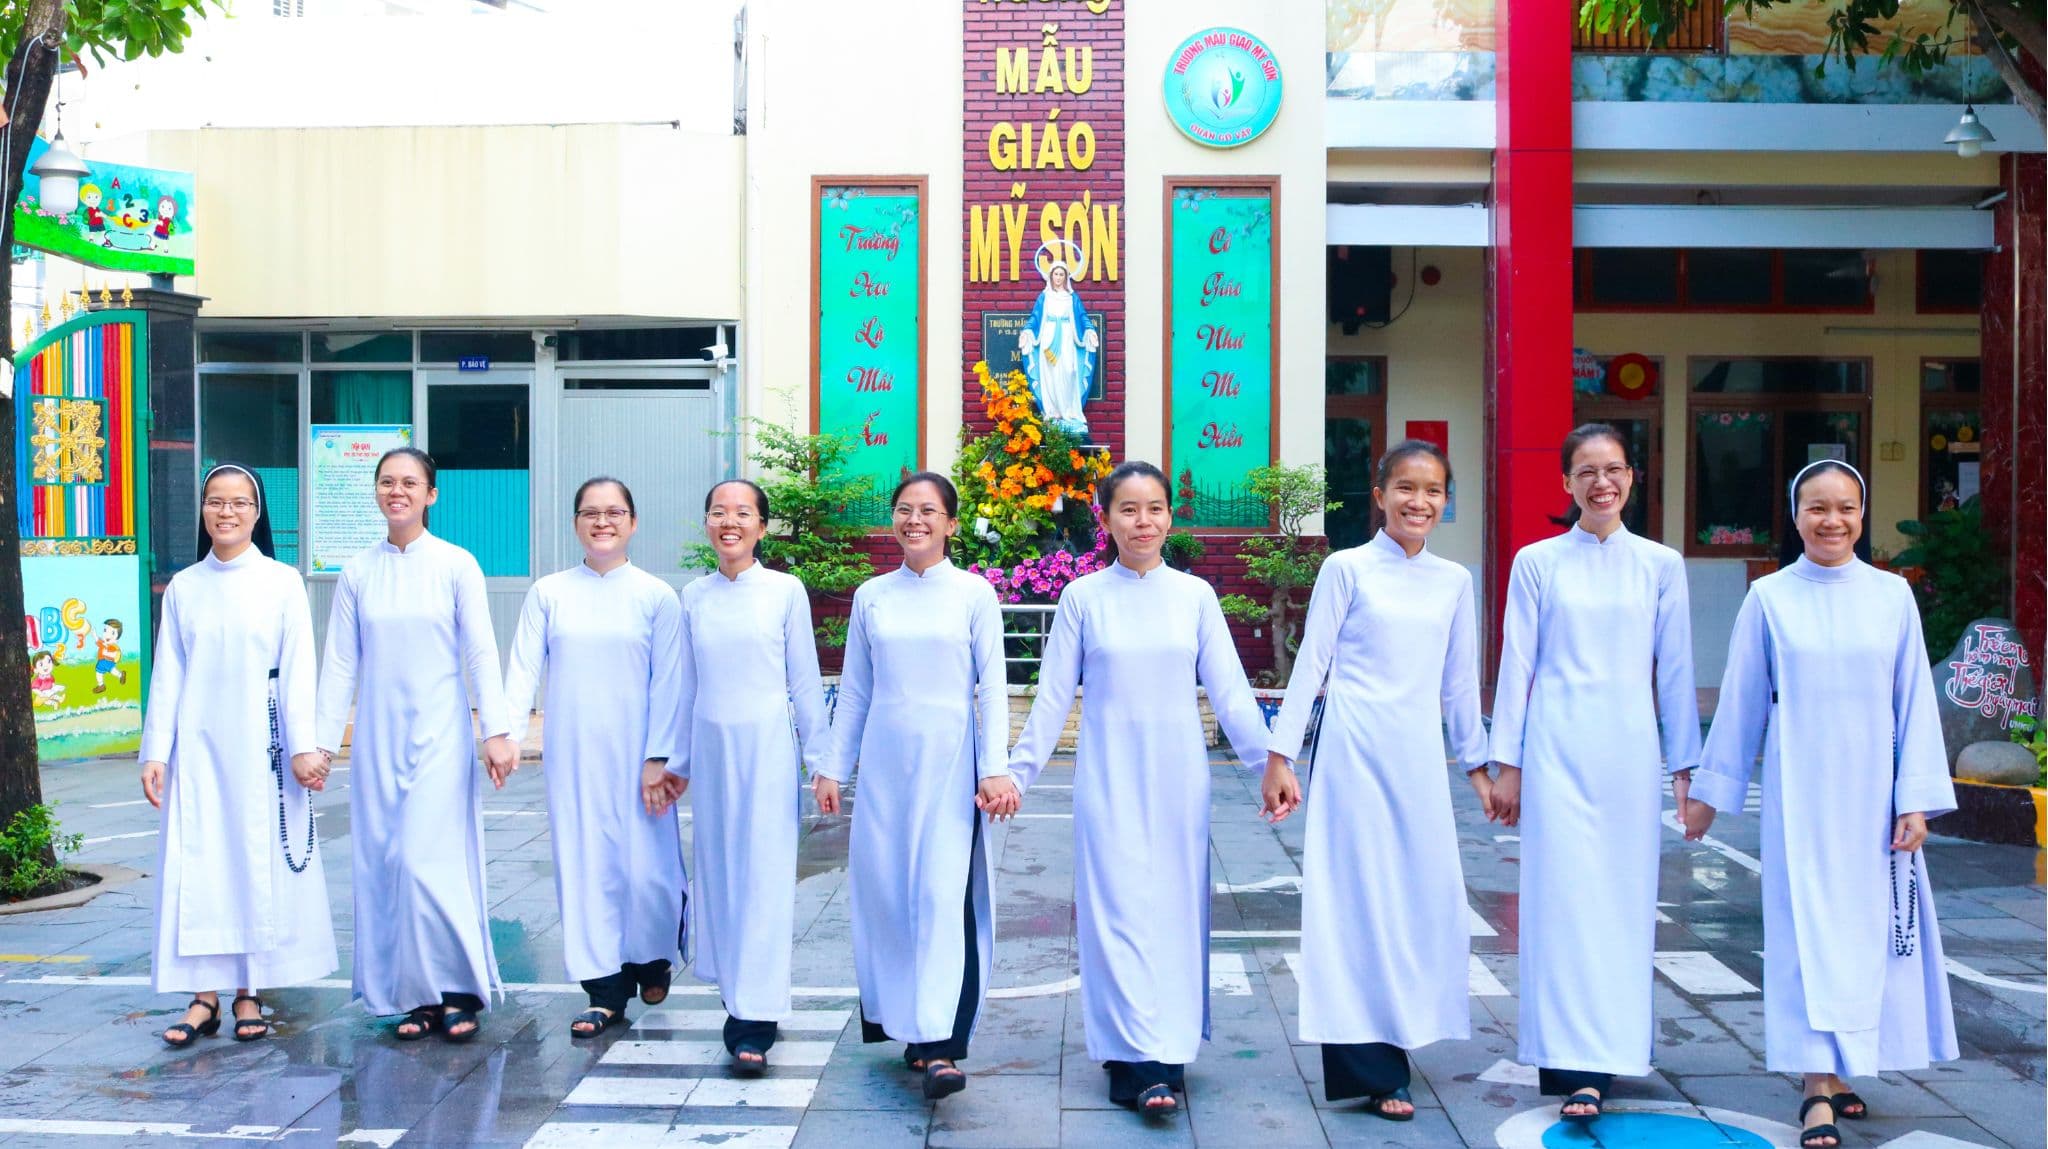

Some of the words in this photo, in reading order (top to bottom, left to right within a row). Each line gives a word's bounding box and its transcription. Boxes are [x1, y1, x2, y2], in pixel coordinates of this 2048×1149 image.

[996, 23, 1093, 94] MẪU
[988, 108, 1096, 171] GIÁO
[839, 224, 900, 262] Trường
[970, 182, 1029, 283] MỸ
[1038, 190, 1119, 283] SƠN
[849, 271, 890, 300] Học
[1200, 271, 1242, 307] Giáo
[854, 315, 885, 350] Là
[1196, 324, 1246, 351] Như
[846, 365, 893, 393] Mái
[1201, 369, 1241, 400] Mẹ
[1197, 421, 1243, 449] Hiền
